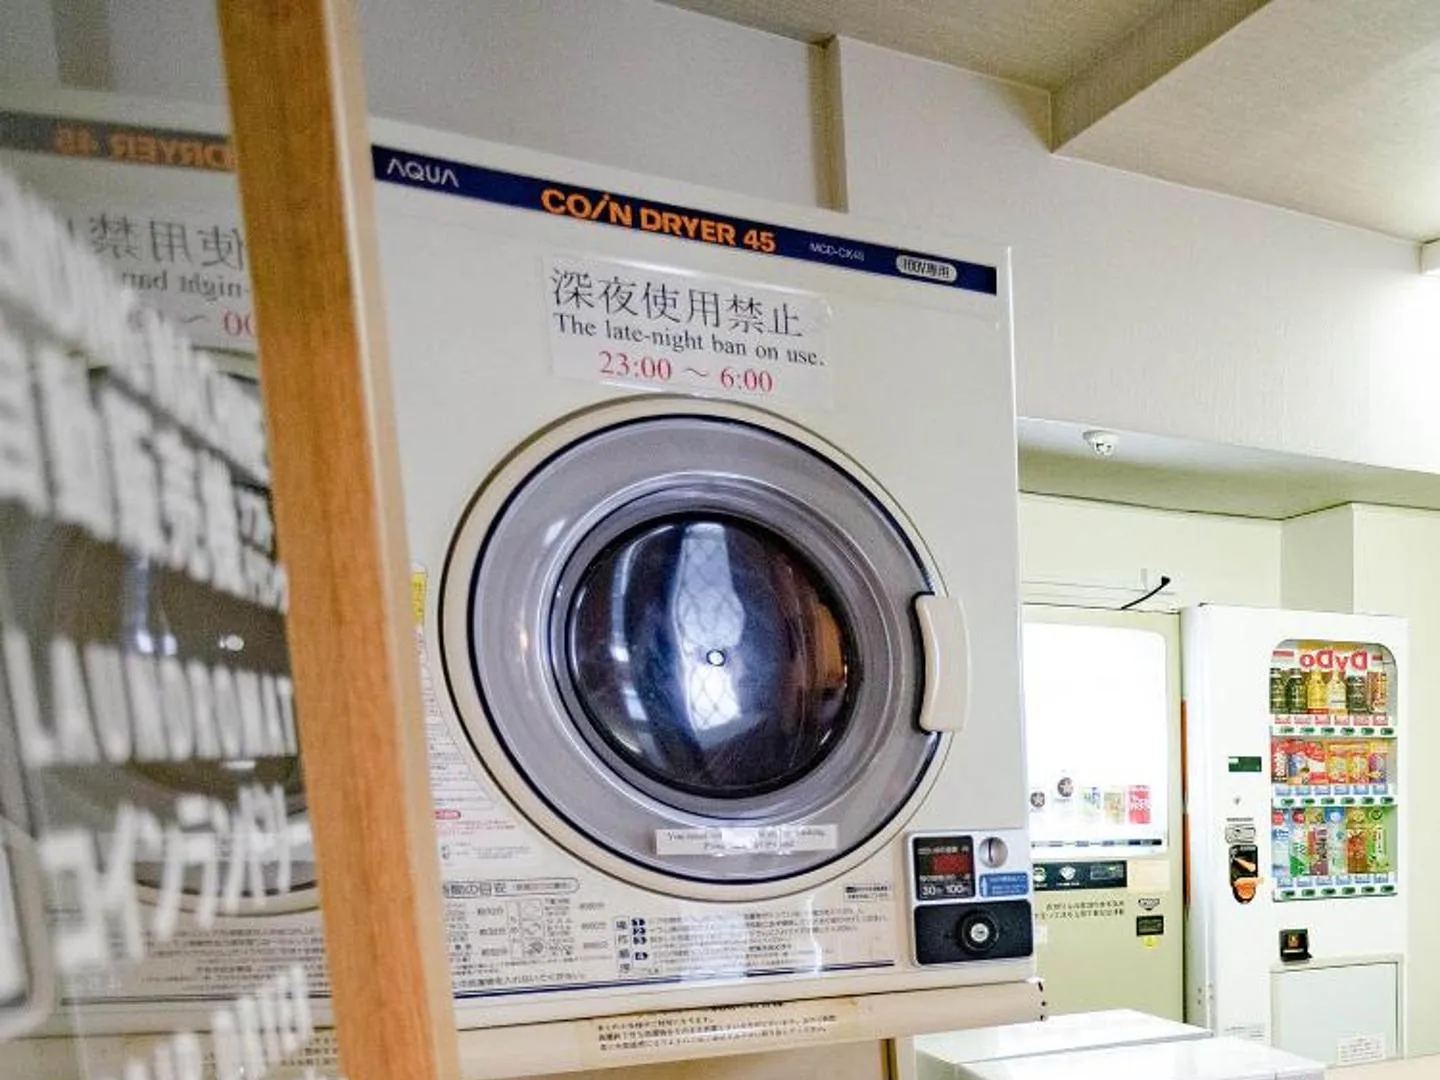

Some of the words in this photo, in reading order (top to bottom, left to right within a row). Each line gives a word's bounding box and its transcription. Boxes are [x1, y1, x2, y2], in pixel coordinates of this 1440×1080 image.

[386, 158, 460, 188] AQUA
[639, 206, 737, 246] DRYER
[743, 229, 777, 253] 45
[550, 268, 804, 337] 深夜使用禁止
[552, 312, 597, 336] The
[606, 320, 704, 352] late-night
[711, 333, 748, 357] ban
[755, 343, 779, 360] on
[786, 348, 825, 366] use.
[599, 350, 673, 381] 23:00
[720, 365, 774, 393] 6:00
